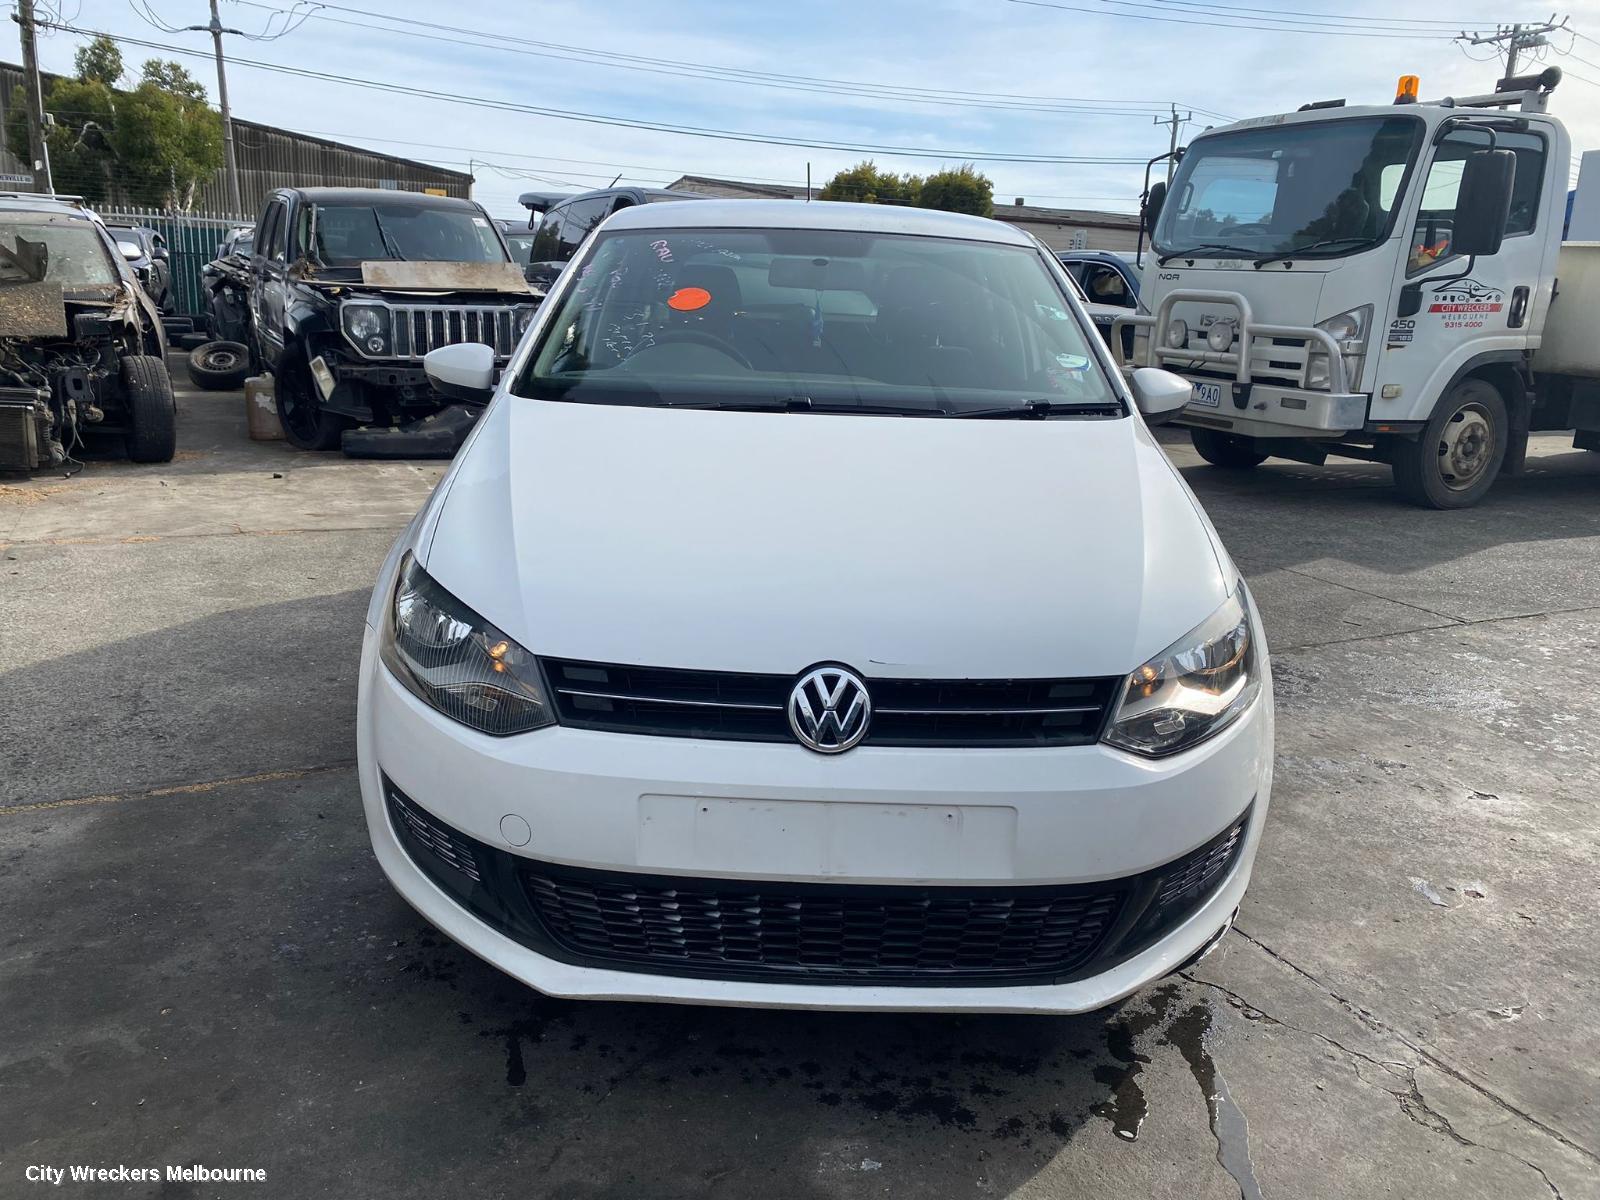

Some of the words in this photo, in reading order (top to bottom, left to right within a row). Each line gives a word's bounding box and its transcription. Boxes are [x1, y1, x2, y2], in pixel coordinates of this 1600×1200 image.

[1441, 304, 1457, 312] CITY
[1458, 304, 1492, 312] WRECKERS
[1390, 319, 1416, 329] 450
[792, 671, 868, 750] VW
